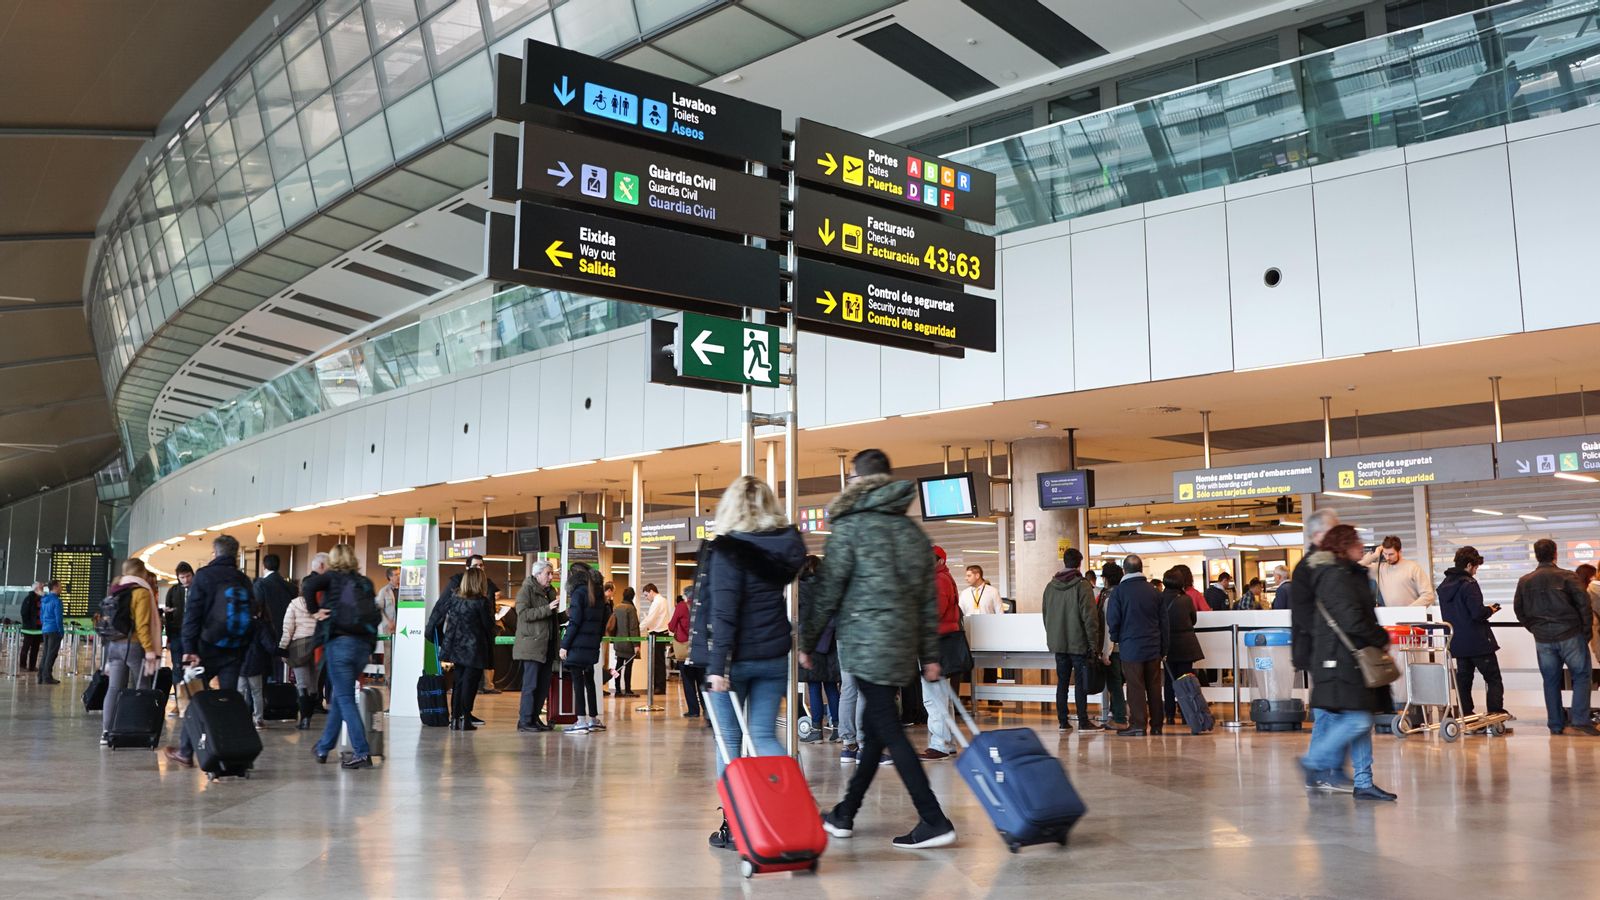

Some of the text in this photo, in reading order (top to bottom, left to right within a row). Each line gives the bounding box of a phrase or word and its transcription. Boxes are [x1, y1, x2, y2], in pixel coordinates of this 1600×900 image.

[672, 91, 717, 115] Lavabos
[673, 107, 699, 124] Toilets
[671, 121, 704, 140] Aseos
[868, 149, 898, 168] Portes
[648, 163, 716, 191] Guàrdia Civil
[868, 163, 889, 178] Gates
[910, 161, 967, 188] A B C R
[648, 180, 698, 201] Guardia Civil
[867, 176, 903, 195] Puertas
[910, 184, 951, 206] D E F
[648, 194, 716, 220] Guardia Civil
[579, 226, 616, 246] Eixida
[867, 215, 915, 239] Facturació
[867, 230, 897, 247] Check-in
[580, 243, 616, 261] Way out
[866, 243, 920, 266] Facturación
[579, 258, 616, 278] Salida
[923, 245, 980, 280] 43 to a 63
[867, 283, 955, 313] Control de seguretat
[868, 298, 920, 318] Security control
[867, 311, 956, 339] Control de seguridad
[1357, 456, 1433, 470] Control de seguretat
[1357, 467, 1403, 478] Security Control
[1195, 466, 1312, 483] Només amb targeta d'embarcament
[1358, 472, 1435, 486] Control de seguridad
[1196, 483, 1207, 491] Only
[1218, 480, 1240, 488] boarding
[1240, 479, 1253, 487] card
[1196, 490, 1210, 498] Sólo
[1223, 488, 1247, 498] tarjeta
[1247, 487, 1256, 495] de
[1256, 485, 1291, 494] embarque
